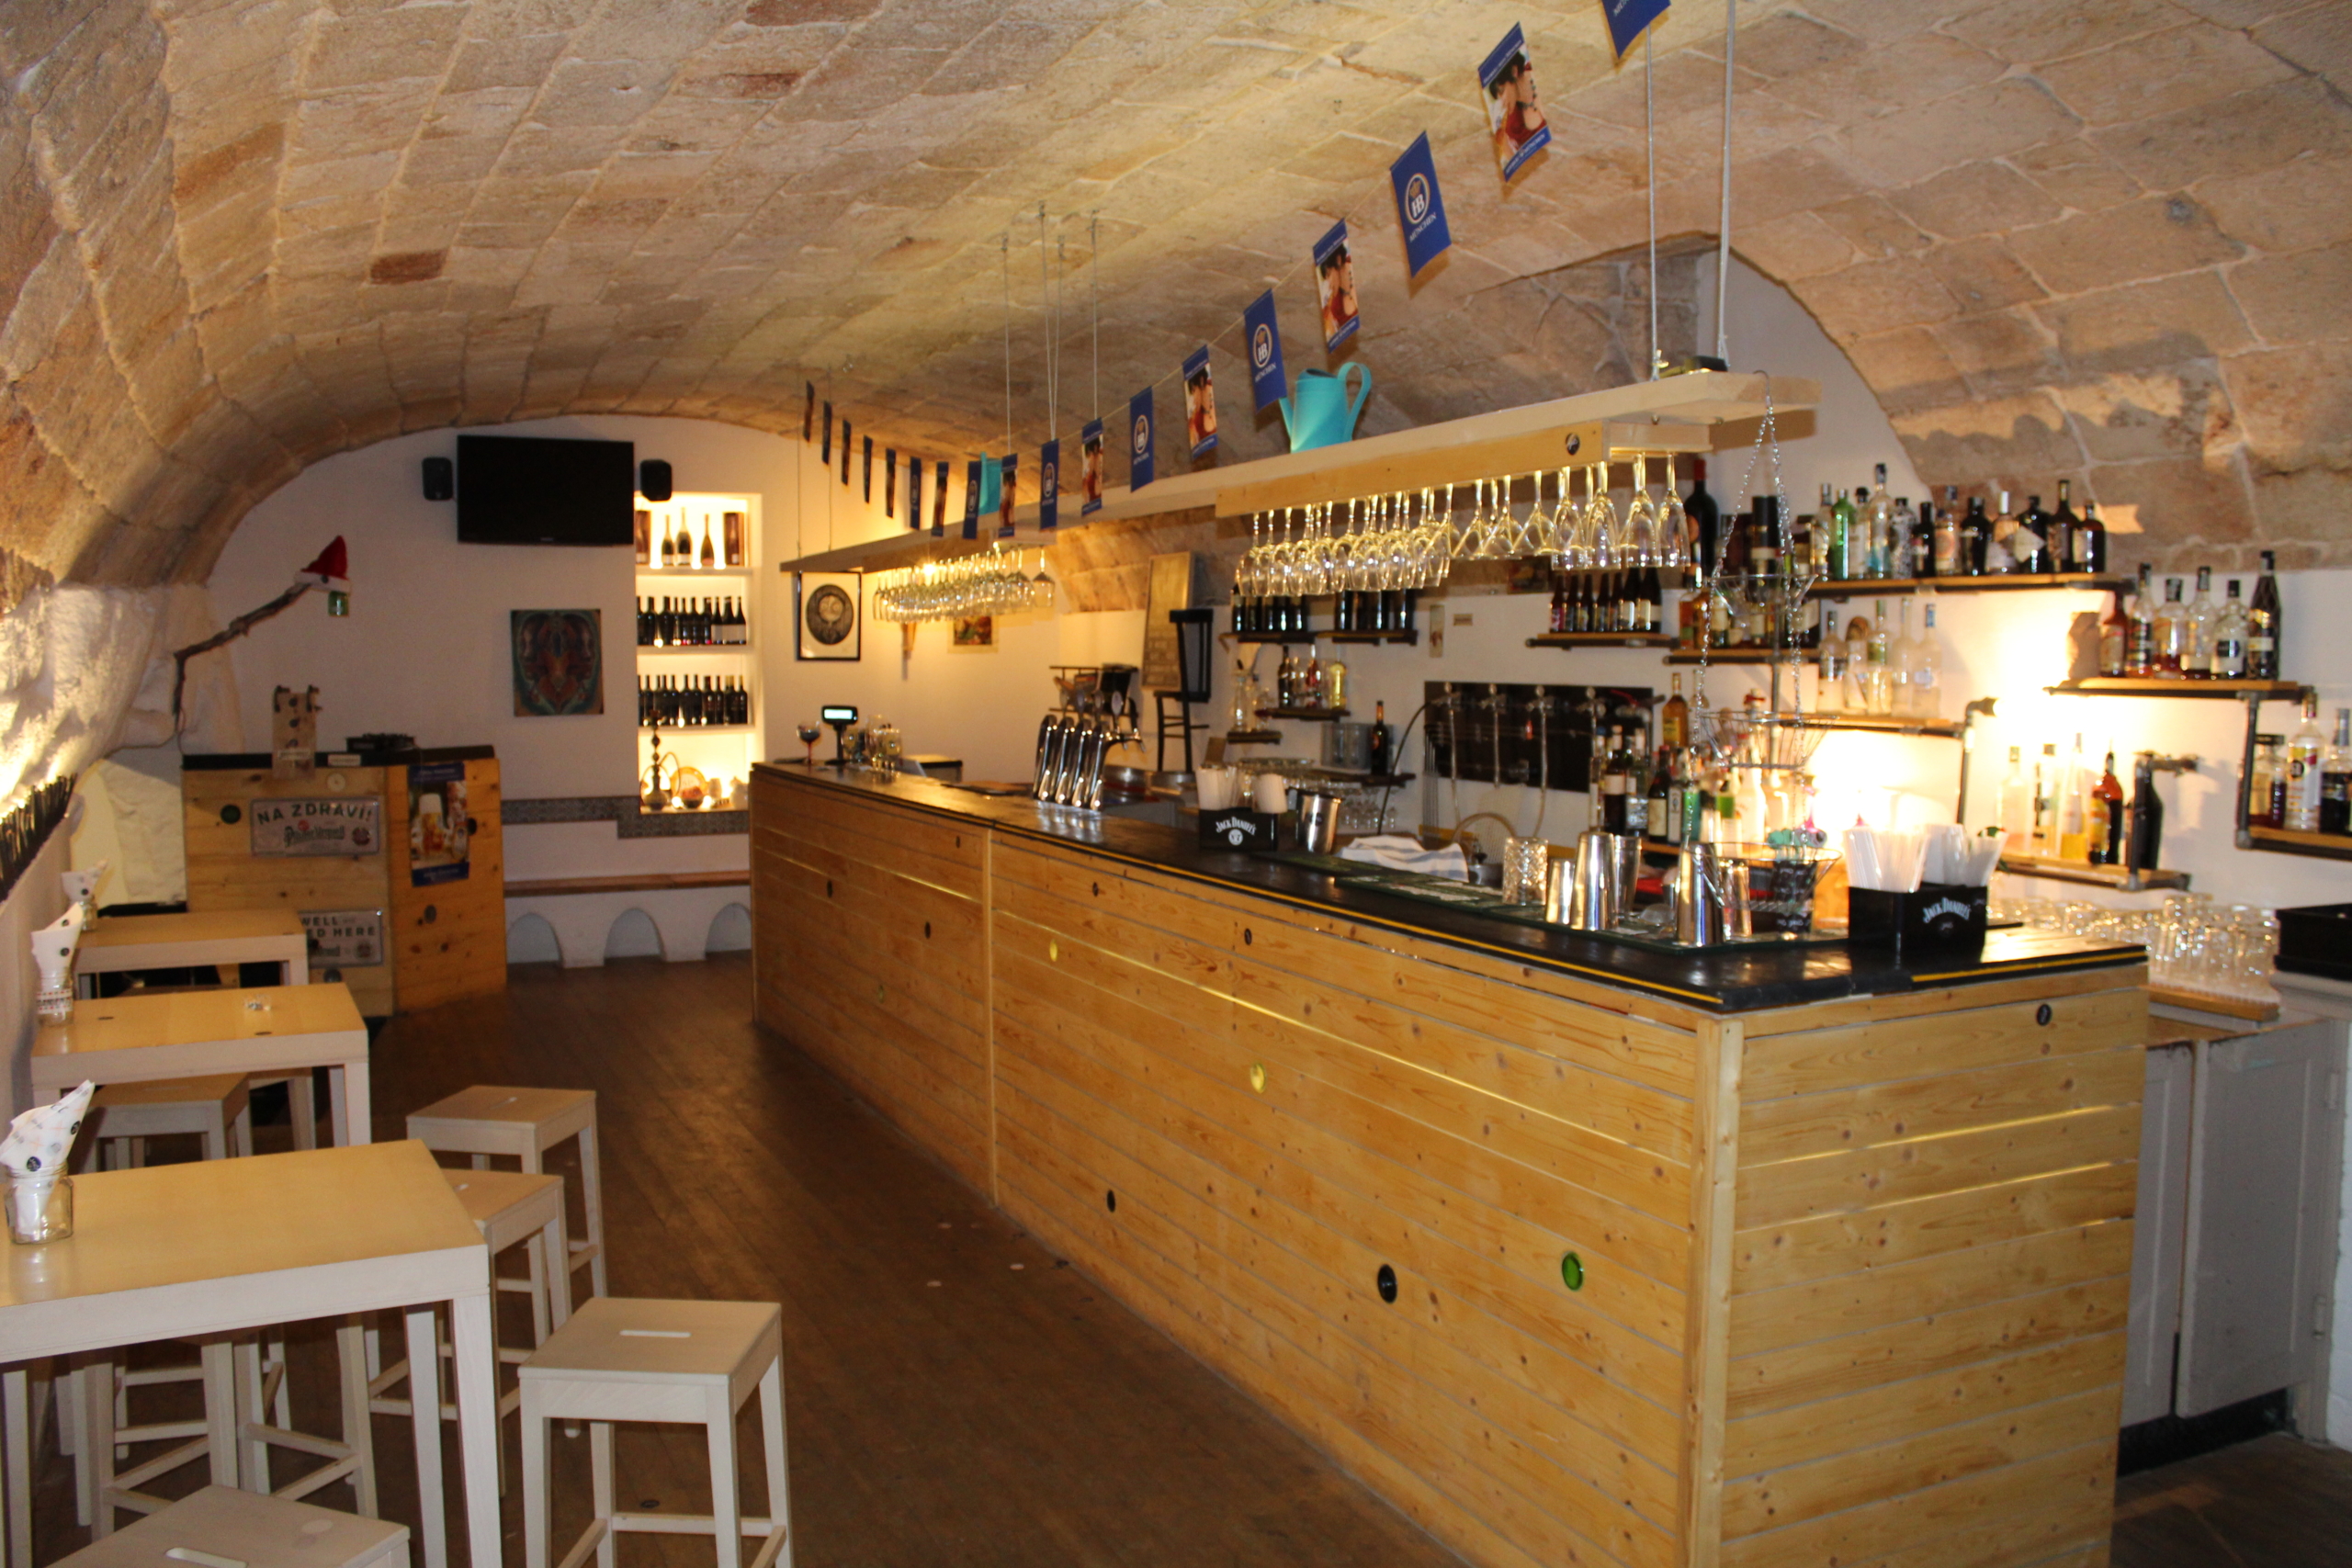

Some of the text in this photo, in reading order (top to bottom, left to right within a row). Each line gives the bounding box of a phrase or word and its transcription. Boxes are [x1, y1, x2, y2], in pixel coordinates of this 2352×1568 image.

[1410, 194, 1426, 219] HB
[1257, 343, 1268, 362] HB
[257, 808, 284, 825] NA
[1215, 819, 1232, 833] JACK
[1922, 897, 1972, 923] JACK DANIEL'S
[333, 926, 375, 937] HERE
